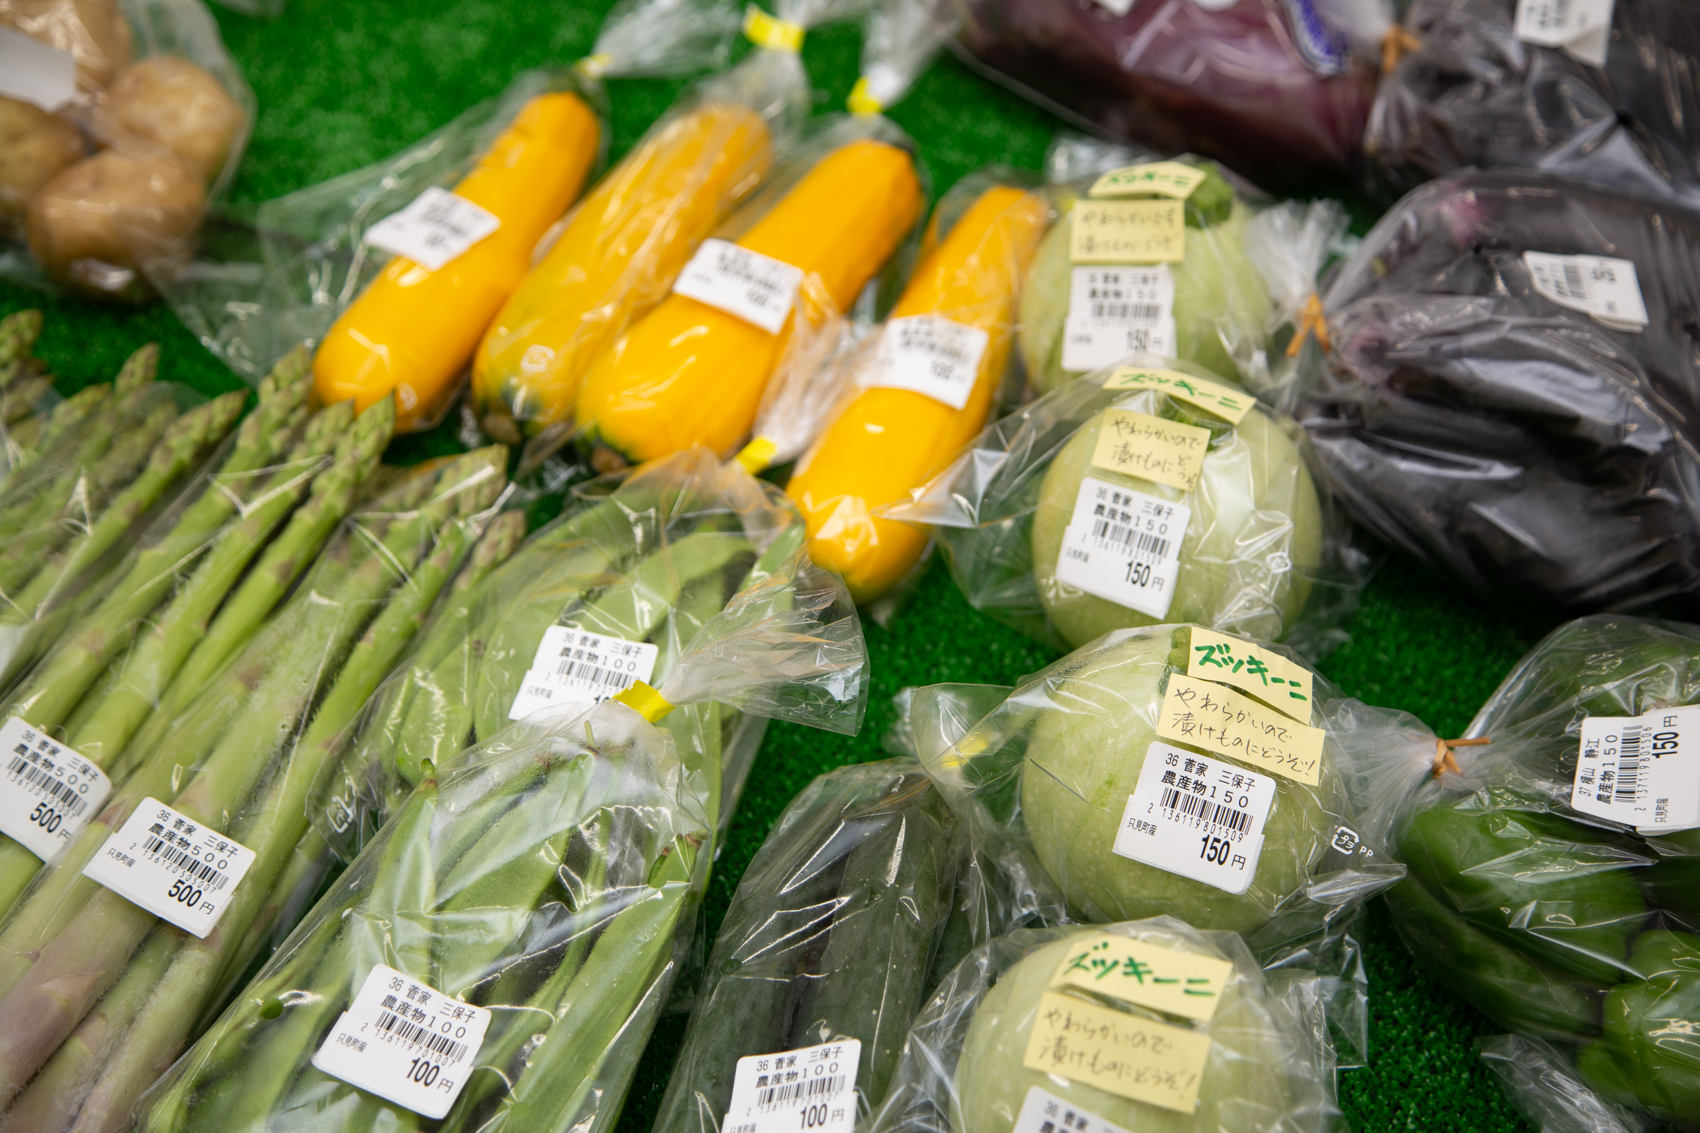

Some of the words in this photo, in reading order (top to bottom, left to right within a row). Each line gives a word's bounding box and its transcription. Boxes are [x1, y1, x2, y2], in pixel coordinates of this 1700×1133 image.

[1111, 416, 1204, 450] やわらかいので
[1093, 503, 1168, 535] 農産物150
[1096, 487, 1108, 500] 36
[1141, 500, 1174, 521] 三保子
[559, 647, 637, 672] 農産物100
[562, 632, 575, 643] 36
[610, 642, 643, 659] 三保子
[1194, 643, 1308, 701] ズッキーニ
[1174, 687, 1292, 743] やわらかいので
[1584, 738, 1600, 759] 静江
[1651, 715, 1680, 759] 150円
[13, 743, 89, 794] 農産物500
[21, 730, 36, 743] 36
[37, 739, 61, 758] 菅家
[67, 757, 99, 782] 三保子
[1596, 734, 1619, 805] 農産物150
[1161, 770, 1249, 808] 農産物150
[1165, 753, 1179, 767] 36
[1183, 757, 1209, 778] 菅家
[1218, 769, 1256, 793] 三保子
[1580, 767, 1597, 785] 横山
[1147, 802, 1154, 814] 2
[1578, 787, 1592, 797] 37
[1655, 797, 1669, 823] 只見町産
[156, 810, 171, 822] 36
[173, 817, 197, 837] 菅家
[203, 835, 239, 858] 三保子
[1127, 817, 1158, 837] 只見町産
[106, 848, 137, 868] 只見町産
[148, 822, 228, 870] 農産物500
[1200, 834, 1247, 870] 150円
[1358, 845, 1374, 858] PP
[168, 879, 215, 915] 500円
[380, 994, 466, 1039] 農産物100
[388, 976, 404, 992] 36
[405, 984, 432, 1006] 菅家
[439, 1002, 476, 1024] 三保子
[335, 1032, 368, 1054] 只見町産
[360, 1022, 368, 1032] 2
[1043, 1006, 1173, 1055] やわらかいので
[406, 1057, 454, 1094] 100円
[755, 1062, 839, 1088] 農産物100
[756, 1060, 769, 1072] 36
[775, 1055, 797, 1071] 菅家
[808, 1046, 843, 1064] 三保子
[746, 1107, 751, 1117] 2
[800, 1103, 845, 1130] 100円
[1044, 1100, 1059, 1118] 36
